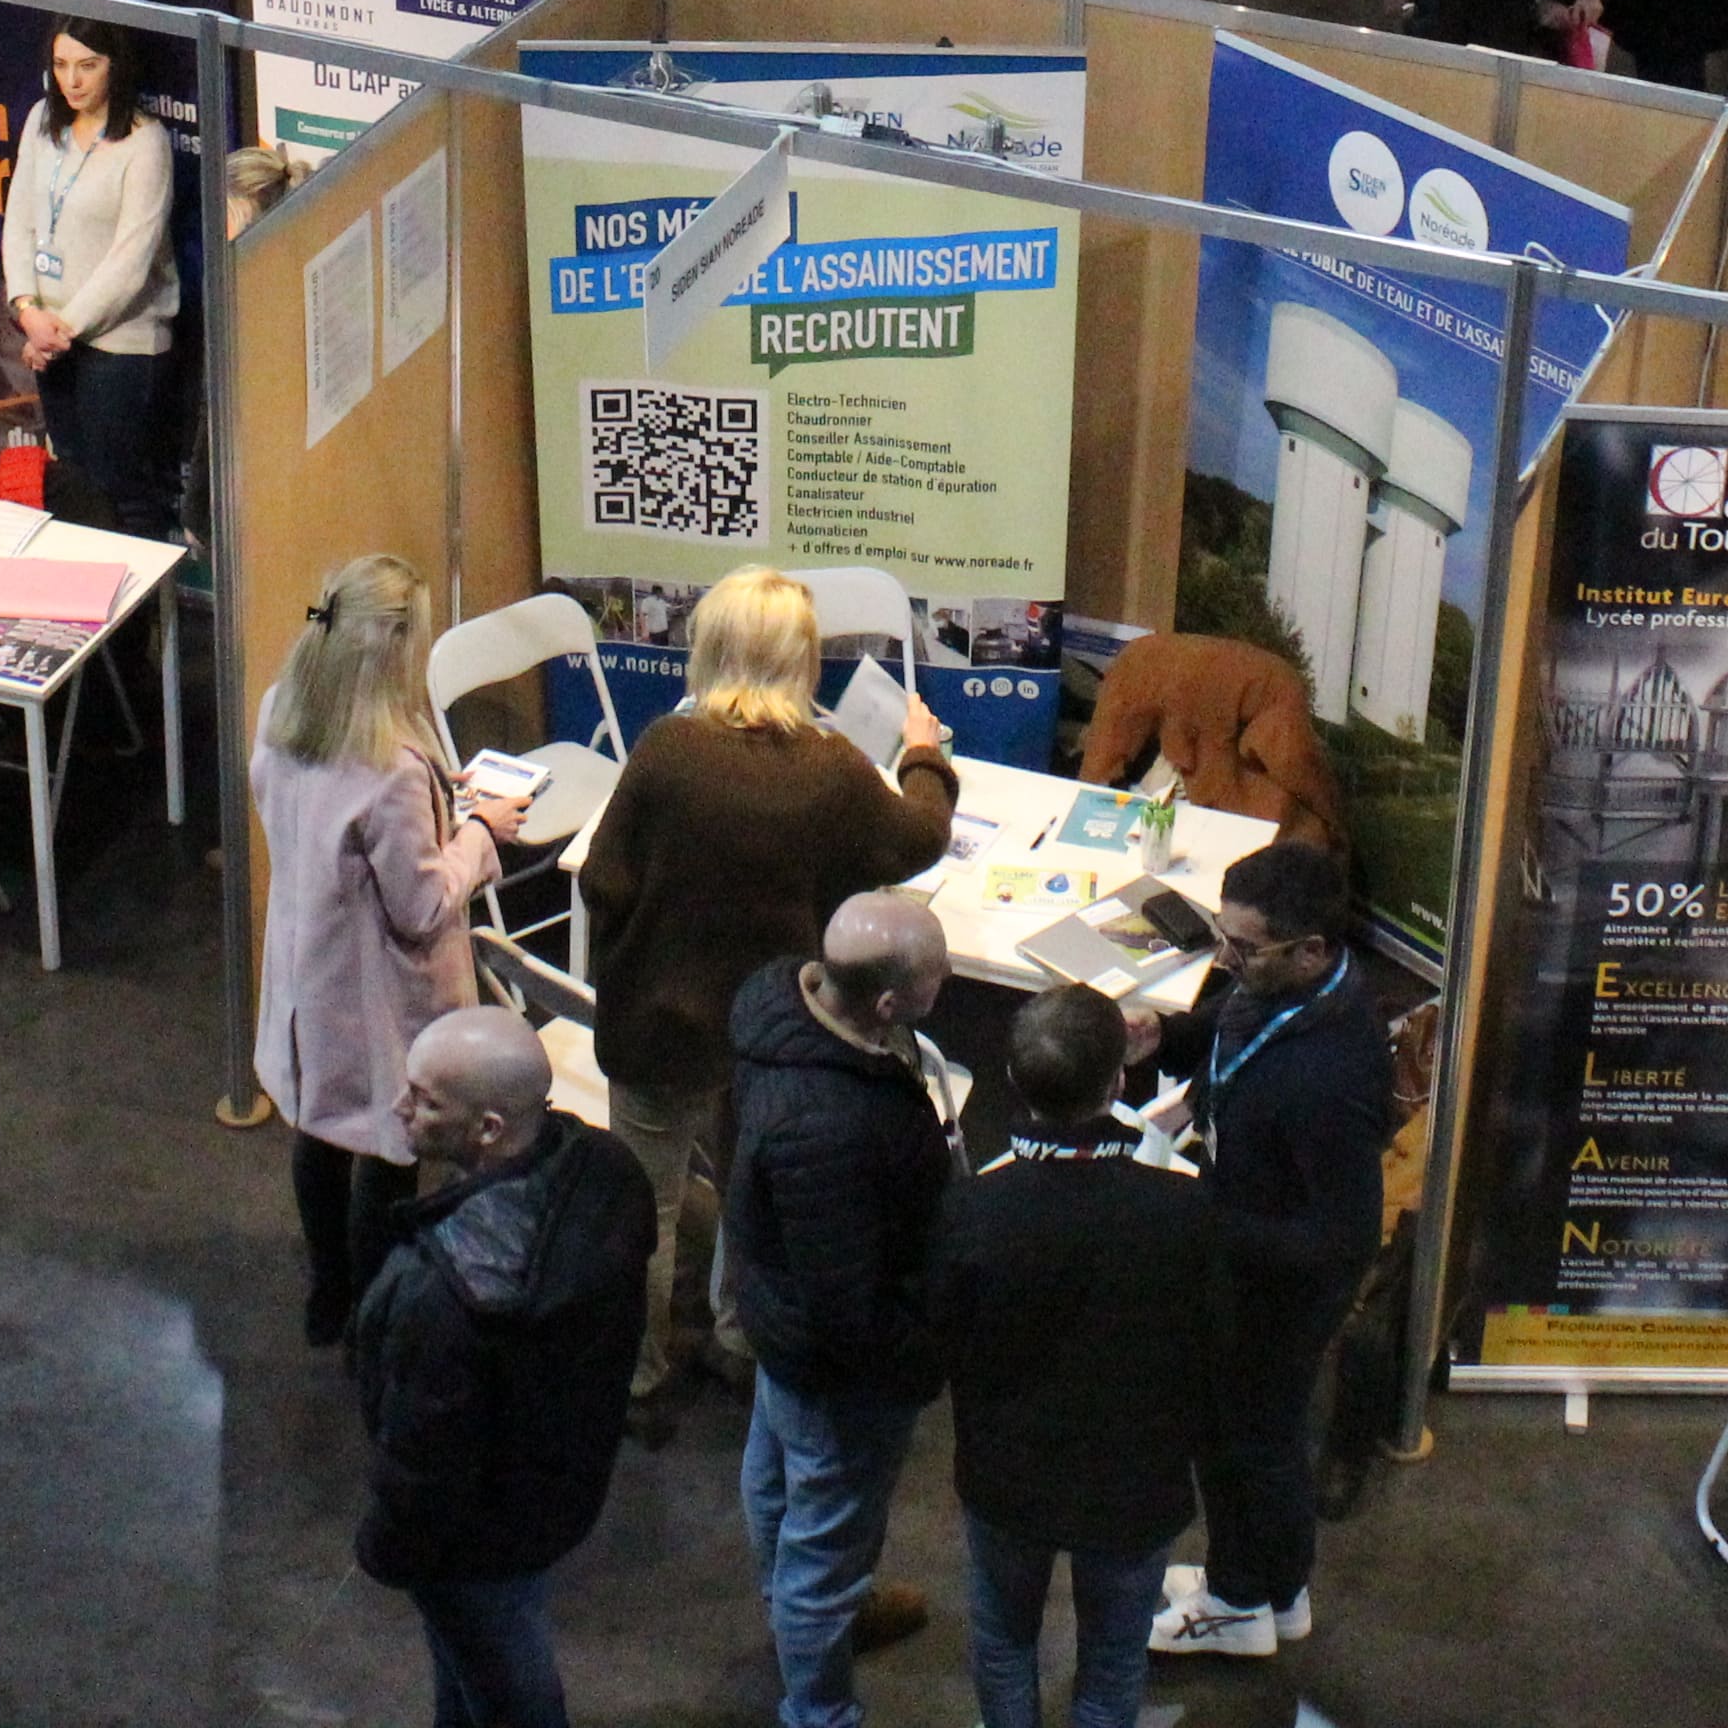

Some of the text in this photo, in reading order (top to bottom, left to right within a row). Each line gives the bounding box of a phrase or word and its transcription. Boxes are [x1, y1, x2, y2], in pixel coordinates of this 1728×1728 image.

[348, 63, 390, 96] CAP
[584, 210, 647, 250] NOS
[1420, 211, 1475, 249] Noréade
[671, 198, 766, 303] SIDEN SIAN NOREADE
[559, 239, 1051, 305] DE L'ASSAINISSEMENT
[1301, 247, 1453, 332] PUBLIC DE L'EAU ET DE
[759, 304, 965, 355] RECRUTENT
[786, 392, 907, 411] Electro-Technicien
[786, 411, 872, 427] Chaudronnier
[786, 429, 952, 454] Conseiller Assainissement
[786, 448, 966, 475] Comptable Aide-Comptable
[786, 466, 998, 494] Conducteur de station d'épuration
[786, 484, 865, 502] Canalisateur
[786, 503, 915, 525] Electricien industriel
[786, 521, 869, 538] Automaticien
[1640, 527, 1678, 552] du
[803, 541, 1035, 572] d'offres d'emploi sur www.noreade.fr
[1578, 582, 1674, 606] Institut
[1585, 607, 1645, 631] Lycée
[1607, 882, 1705, 919] 50%
[1602, 935, 1657, 949] complète
[1603, 923, 1669, 936] Alternance
[1612, 1002, 1689, 1014] enseignement
[1584, 1050, 1687, 1088] LIBERTÉ
[1571, 1135, 1670, 1171] AVENIR
